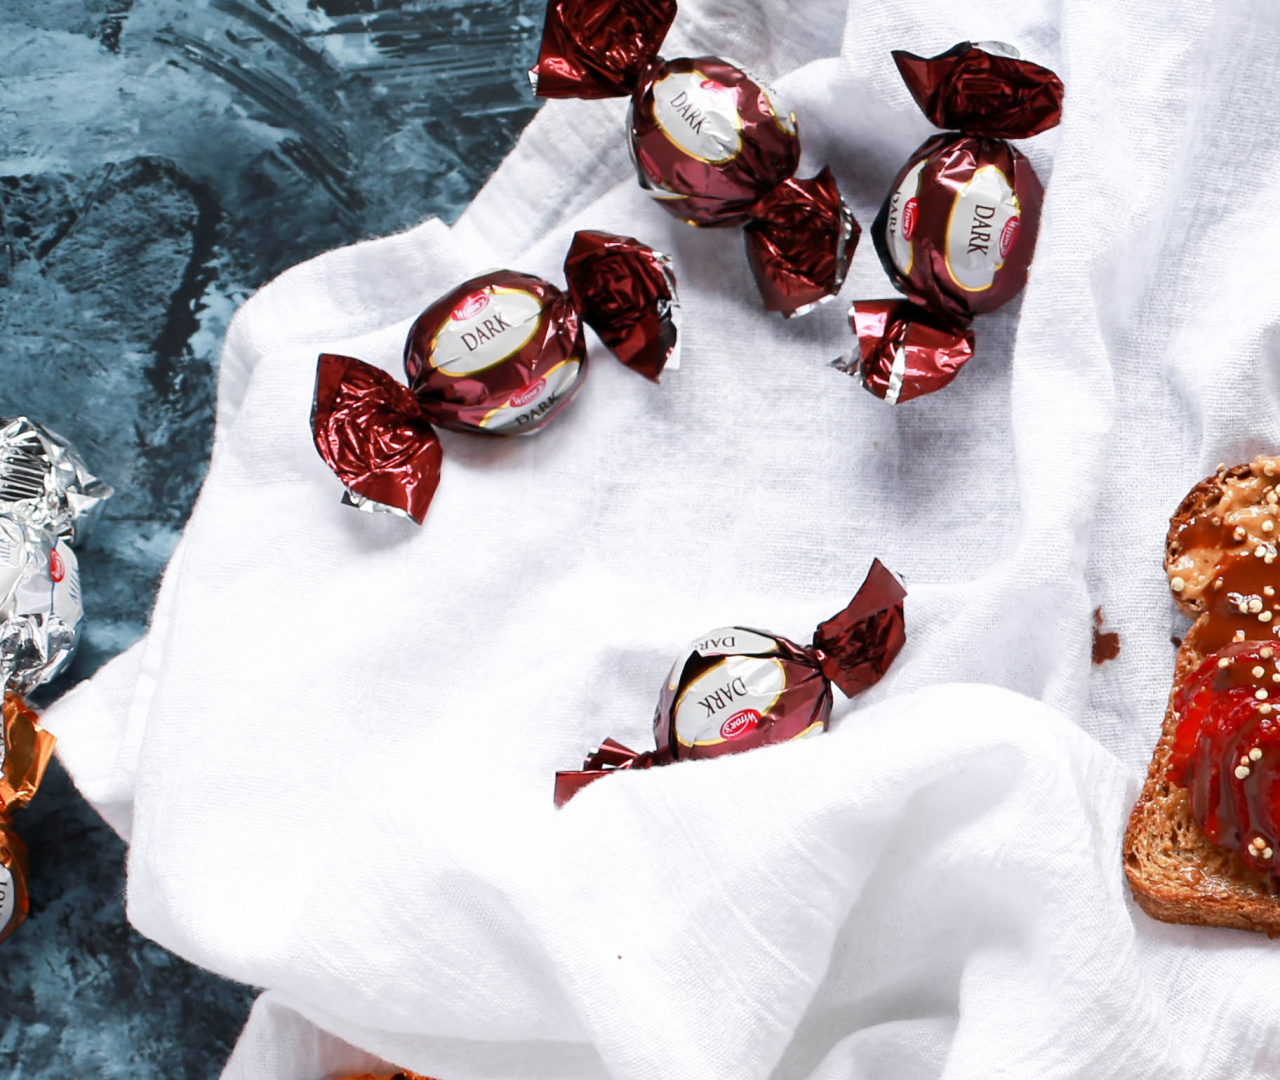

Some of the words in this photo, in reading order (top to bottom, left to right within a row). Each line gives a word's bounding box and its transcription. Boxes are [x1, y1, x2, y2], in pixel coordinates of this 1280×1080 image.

[670, 91, 711, 135] DARK
[966, 204, 996, 256] DARK
[461, 313, 511, 352] DARK
[515, 391, 560, 425] DARK
[697, 677, 748, 718] DARK
